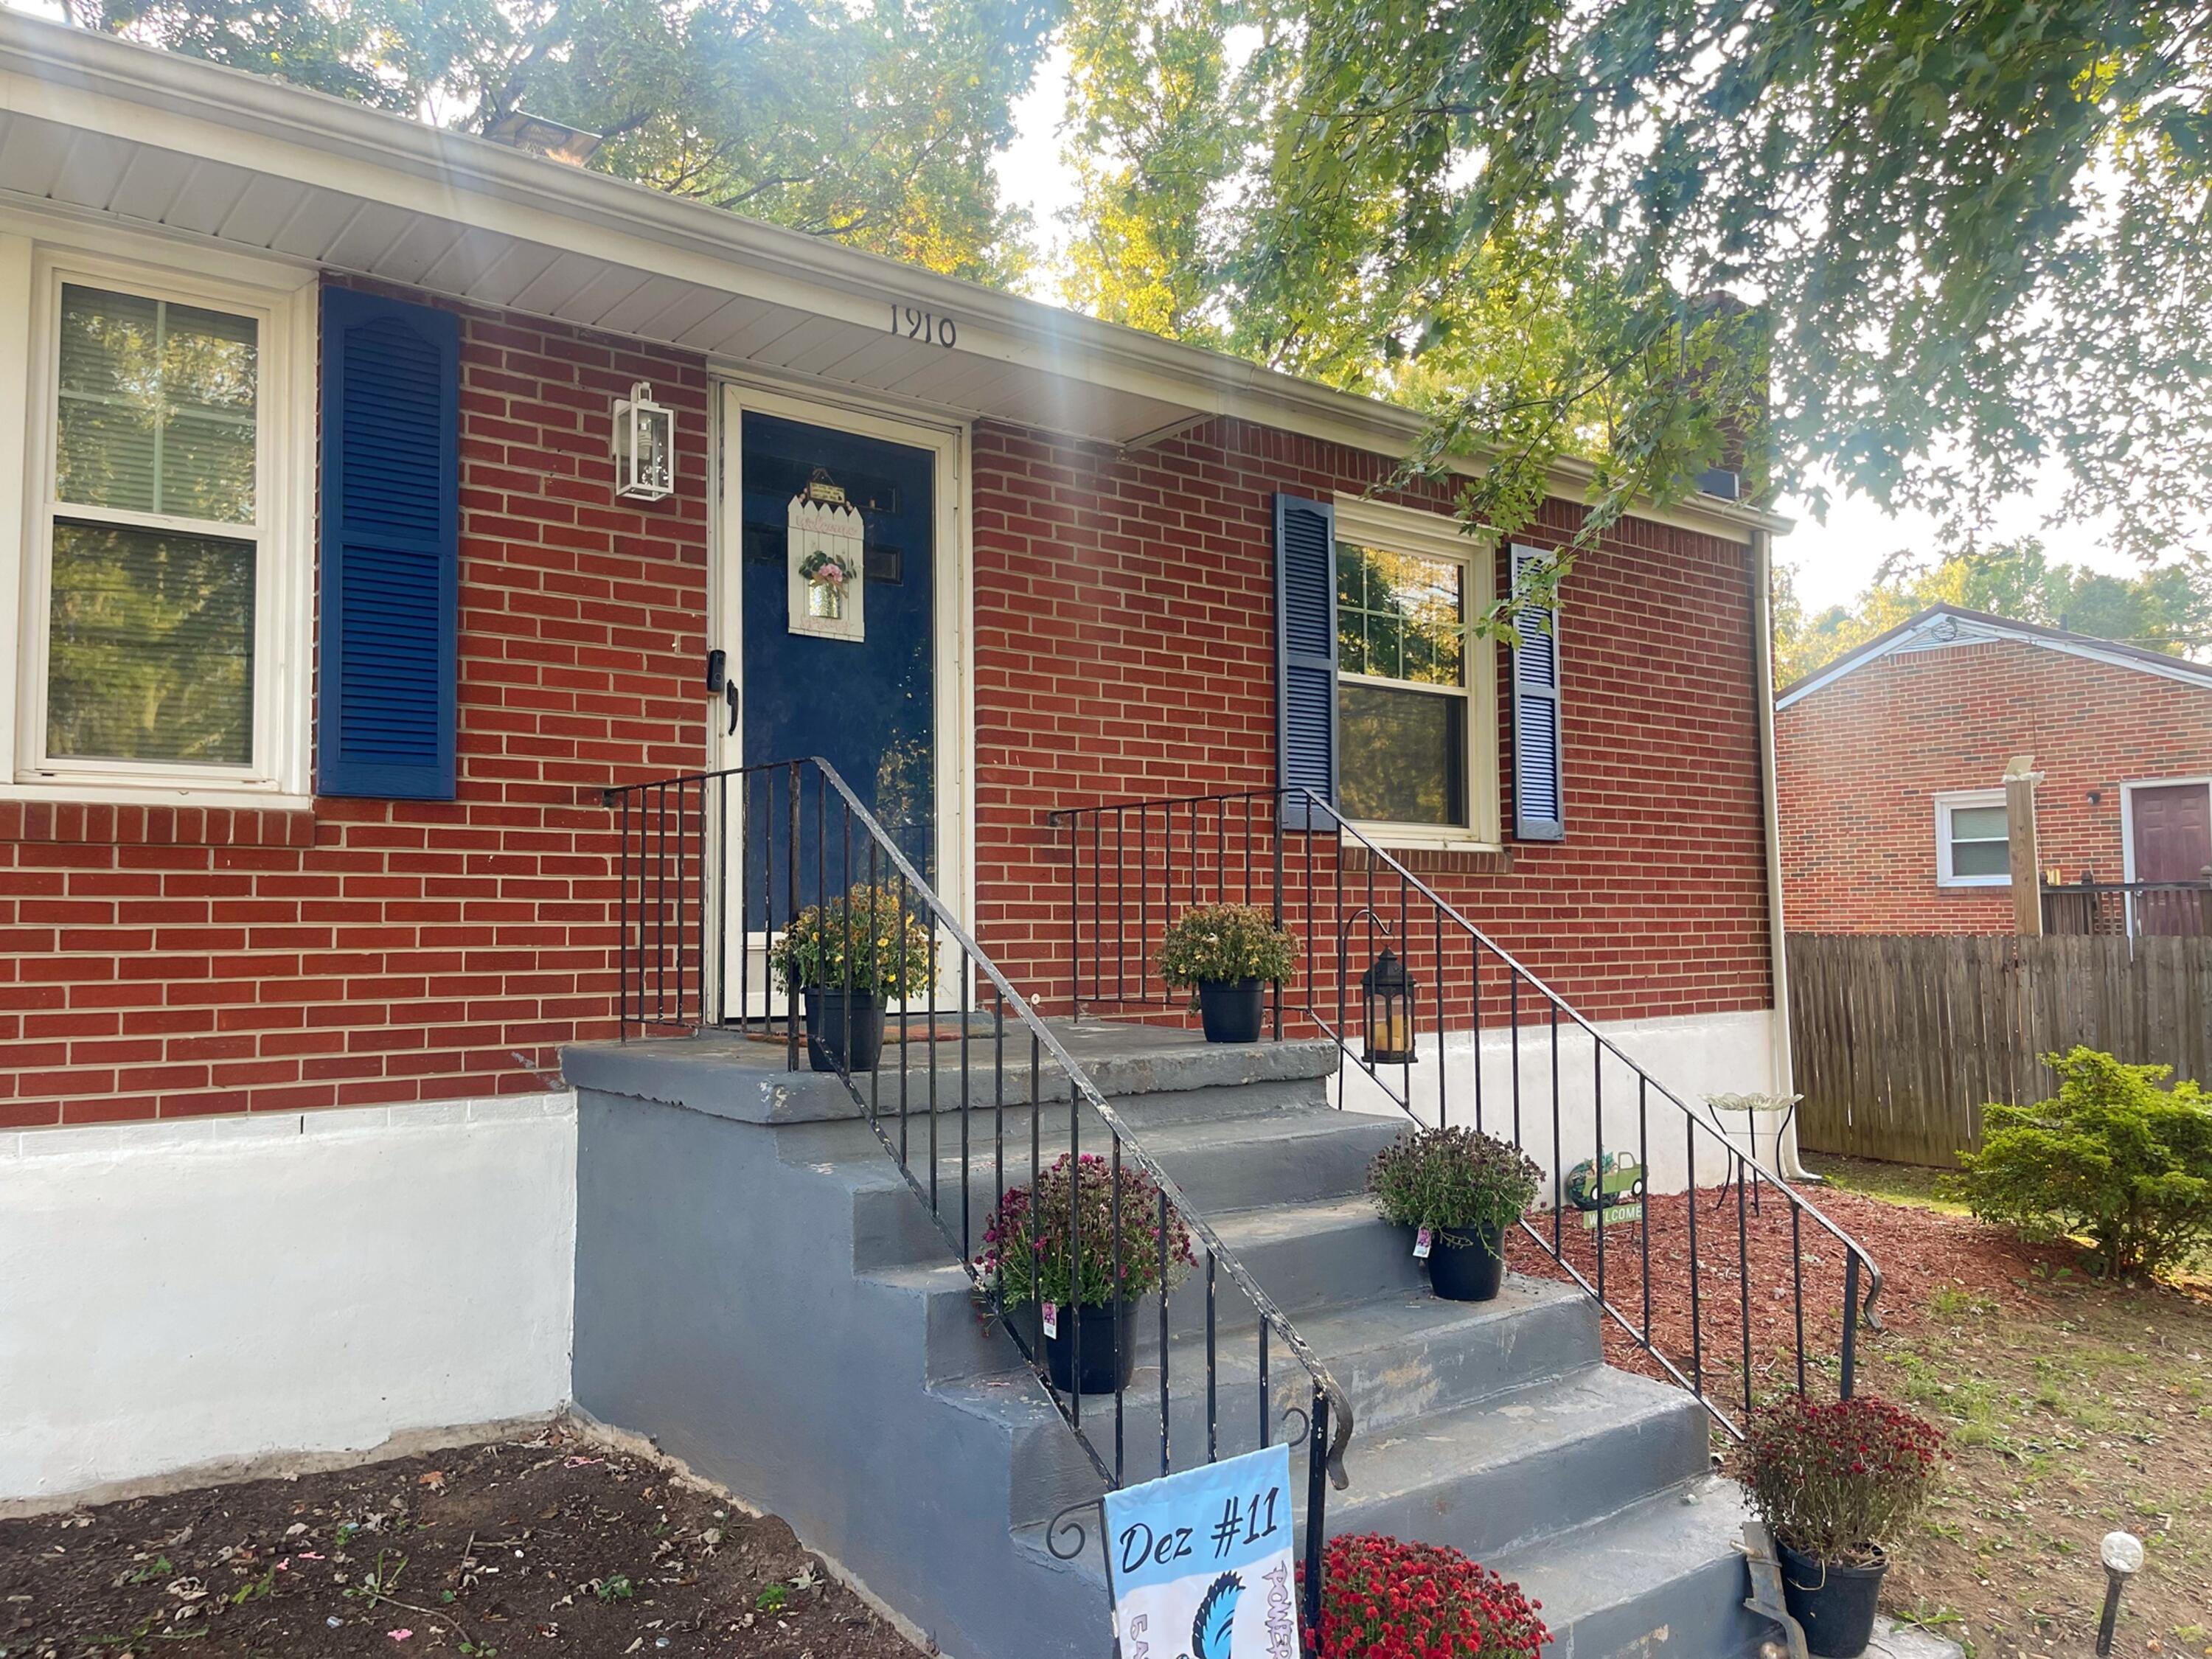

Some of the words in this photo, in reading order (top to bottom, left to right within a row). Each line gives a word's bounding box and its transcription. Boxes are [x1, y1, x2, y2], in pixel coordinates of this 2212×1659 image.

[891, 304, 956, 348] 1910
[1588, 1206, 1642, 1225] WLCOME
[1119, 1523, 1193, 1573] Dez
[1211, 1486, 1279, 1559] #11
